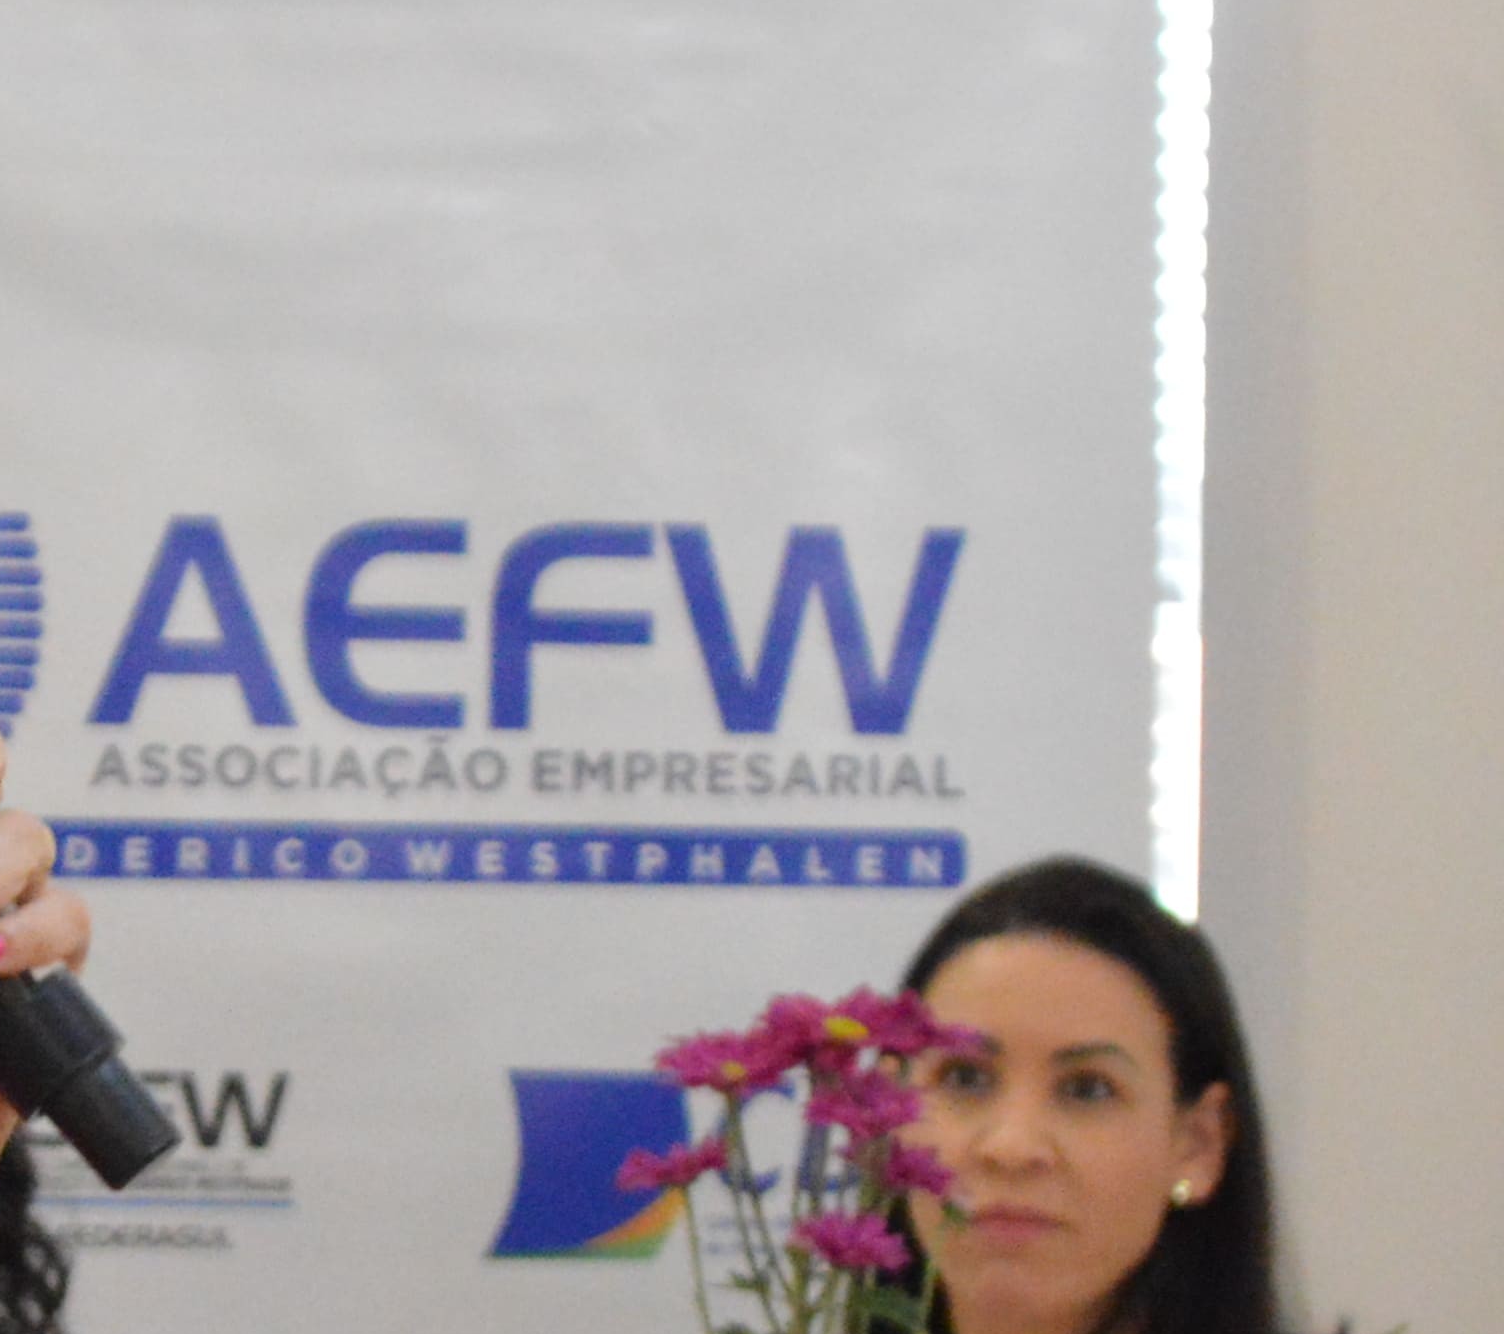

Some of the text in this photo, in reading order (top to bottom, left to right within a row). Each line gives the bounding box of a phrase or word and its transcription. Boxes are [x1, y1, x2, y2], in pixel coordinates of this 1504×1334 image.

[85, 514, 967, 735] AEFW
[89, 735, 966, 799] ASSOCIAÇÃO EMPRESARIAL
[62, 832, 946, 882] DERICO WESTPHALEN
